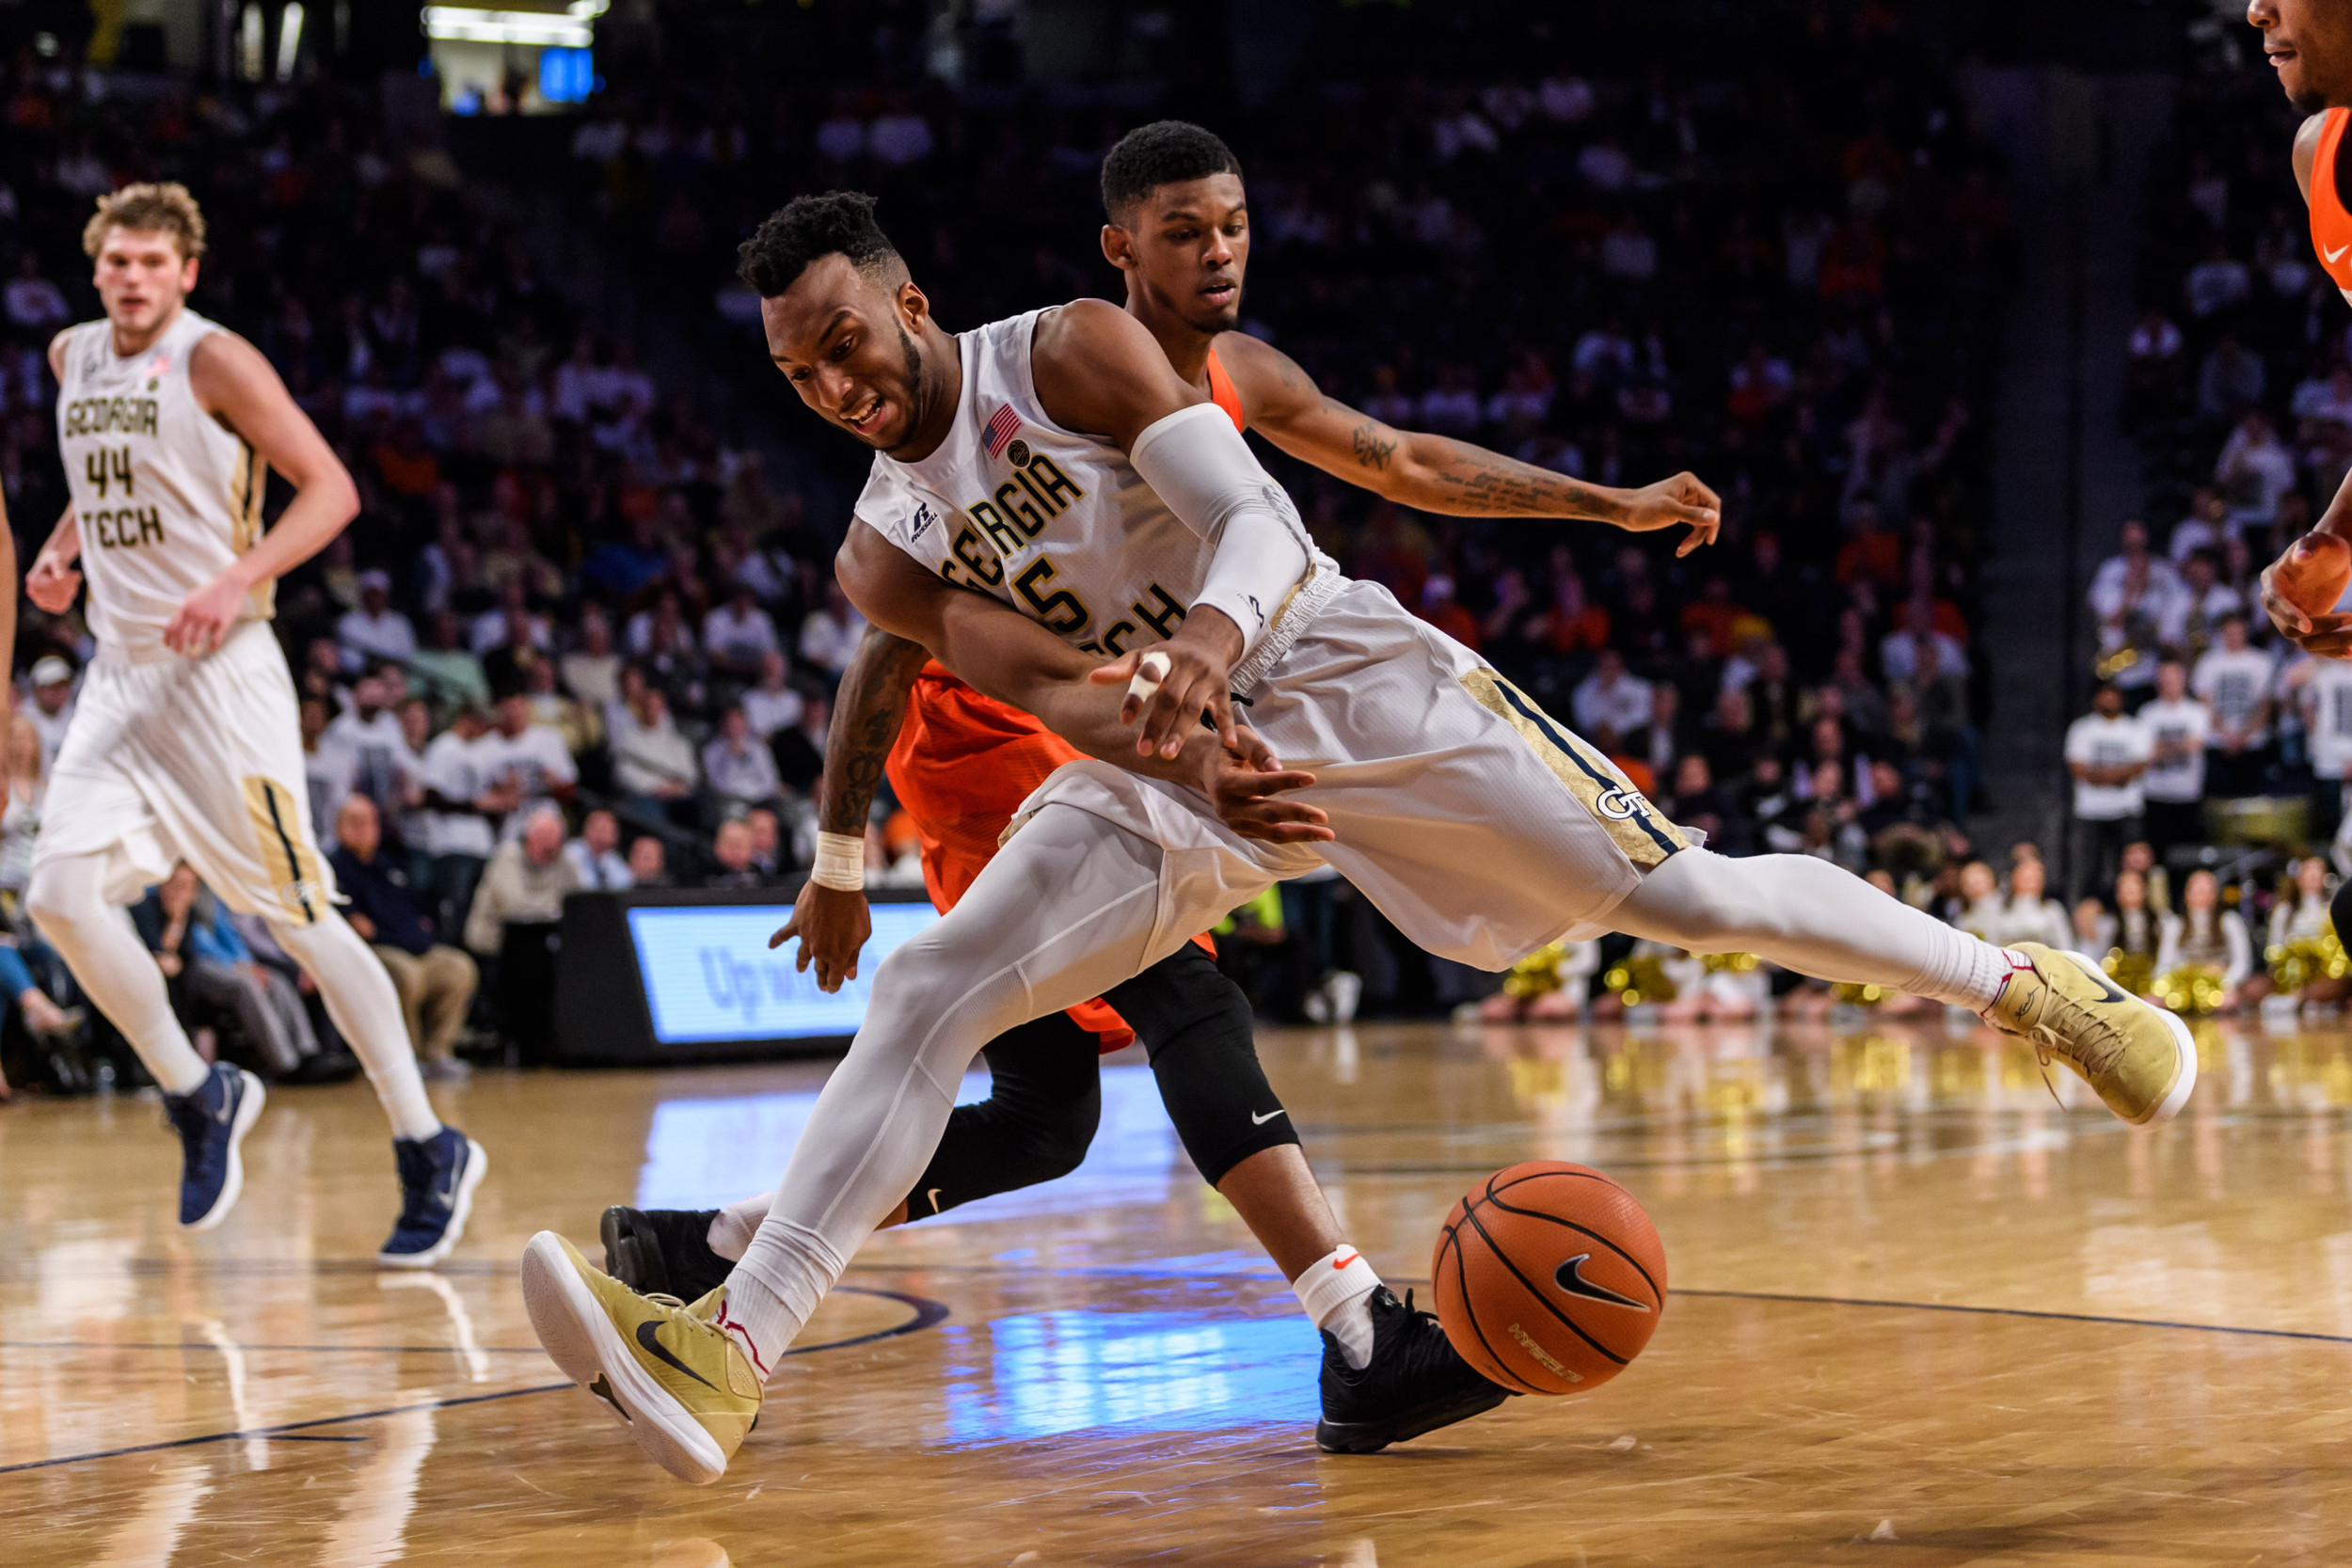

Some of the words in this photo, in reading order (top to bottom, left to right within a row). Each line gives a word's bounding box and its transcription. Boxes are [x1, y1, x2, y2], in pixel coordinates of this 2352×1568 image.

[65, 397, 157, 437] GEORGIA
[86, 444, 134, 499] 44
[82, 505, 164, 548] TECH
[911, 512, 938, 543] RUSSELL
[1009, 553, 1091, 633] 5
[695, 946, 760, 1026] Up
